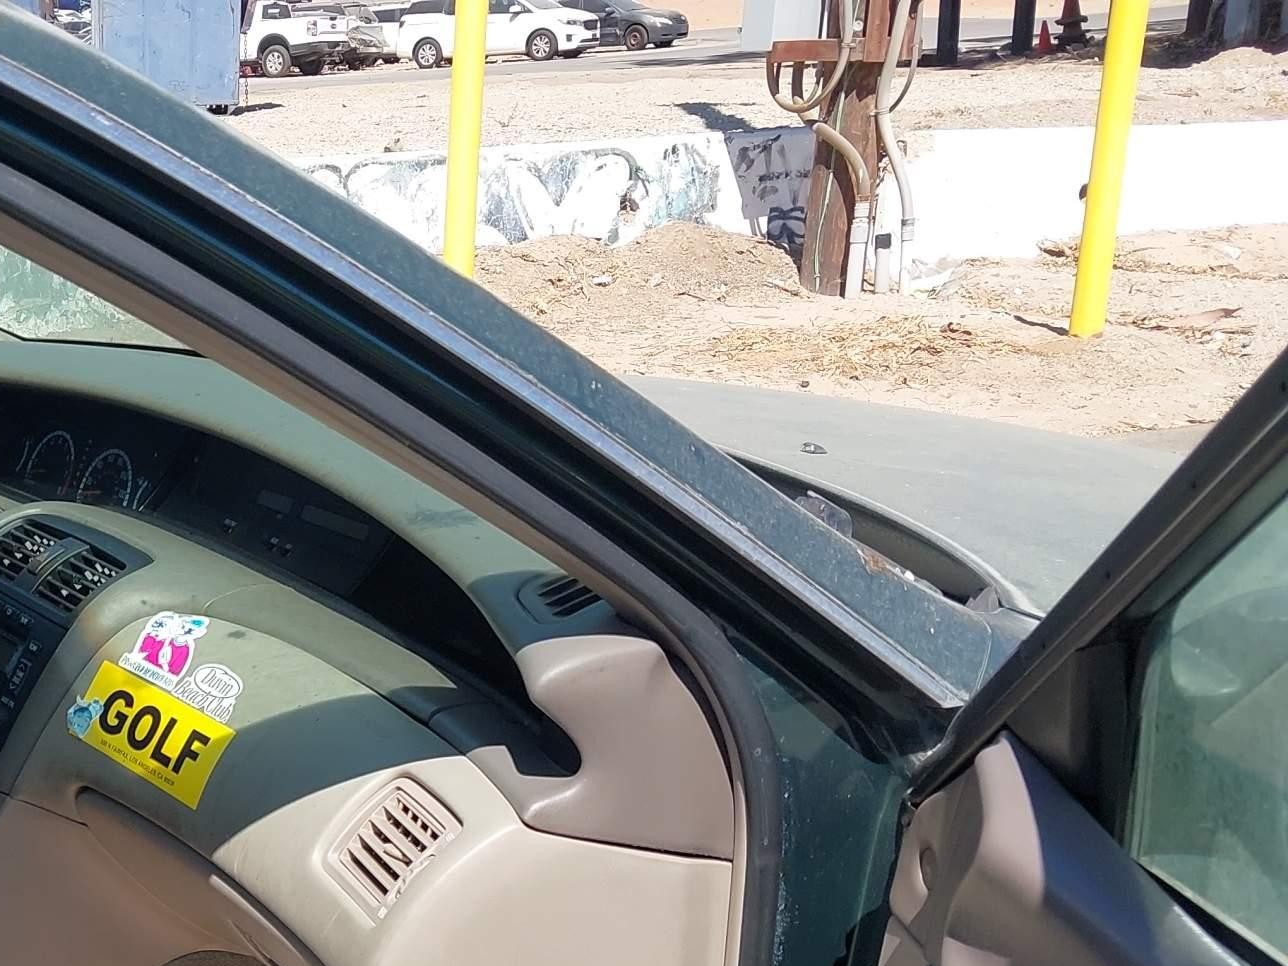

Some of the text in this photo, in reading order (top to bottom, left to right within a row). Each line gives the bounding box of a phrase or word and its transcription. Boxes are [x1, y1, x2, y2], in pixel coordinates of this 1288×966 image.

[174, 680, 210, 708] Beach
[201, 669, 234, 696] Duvin
[98, 689, 211, 775] GOLF
